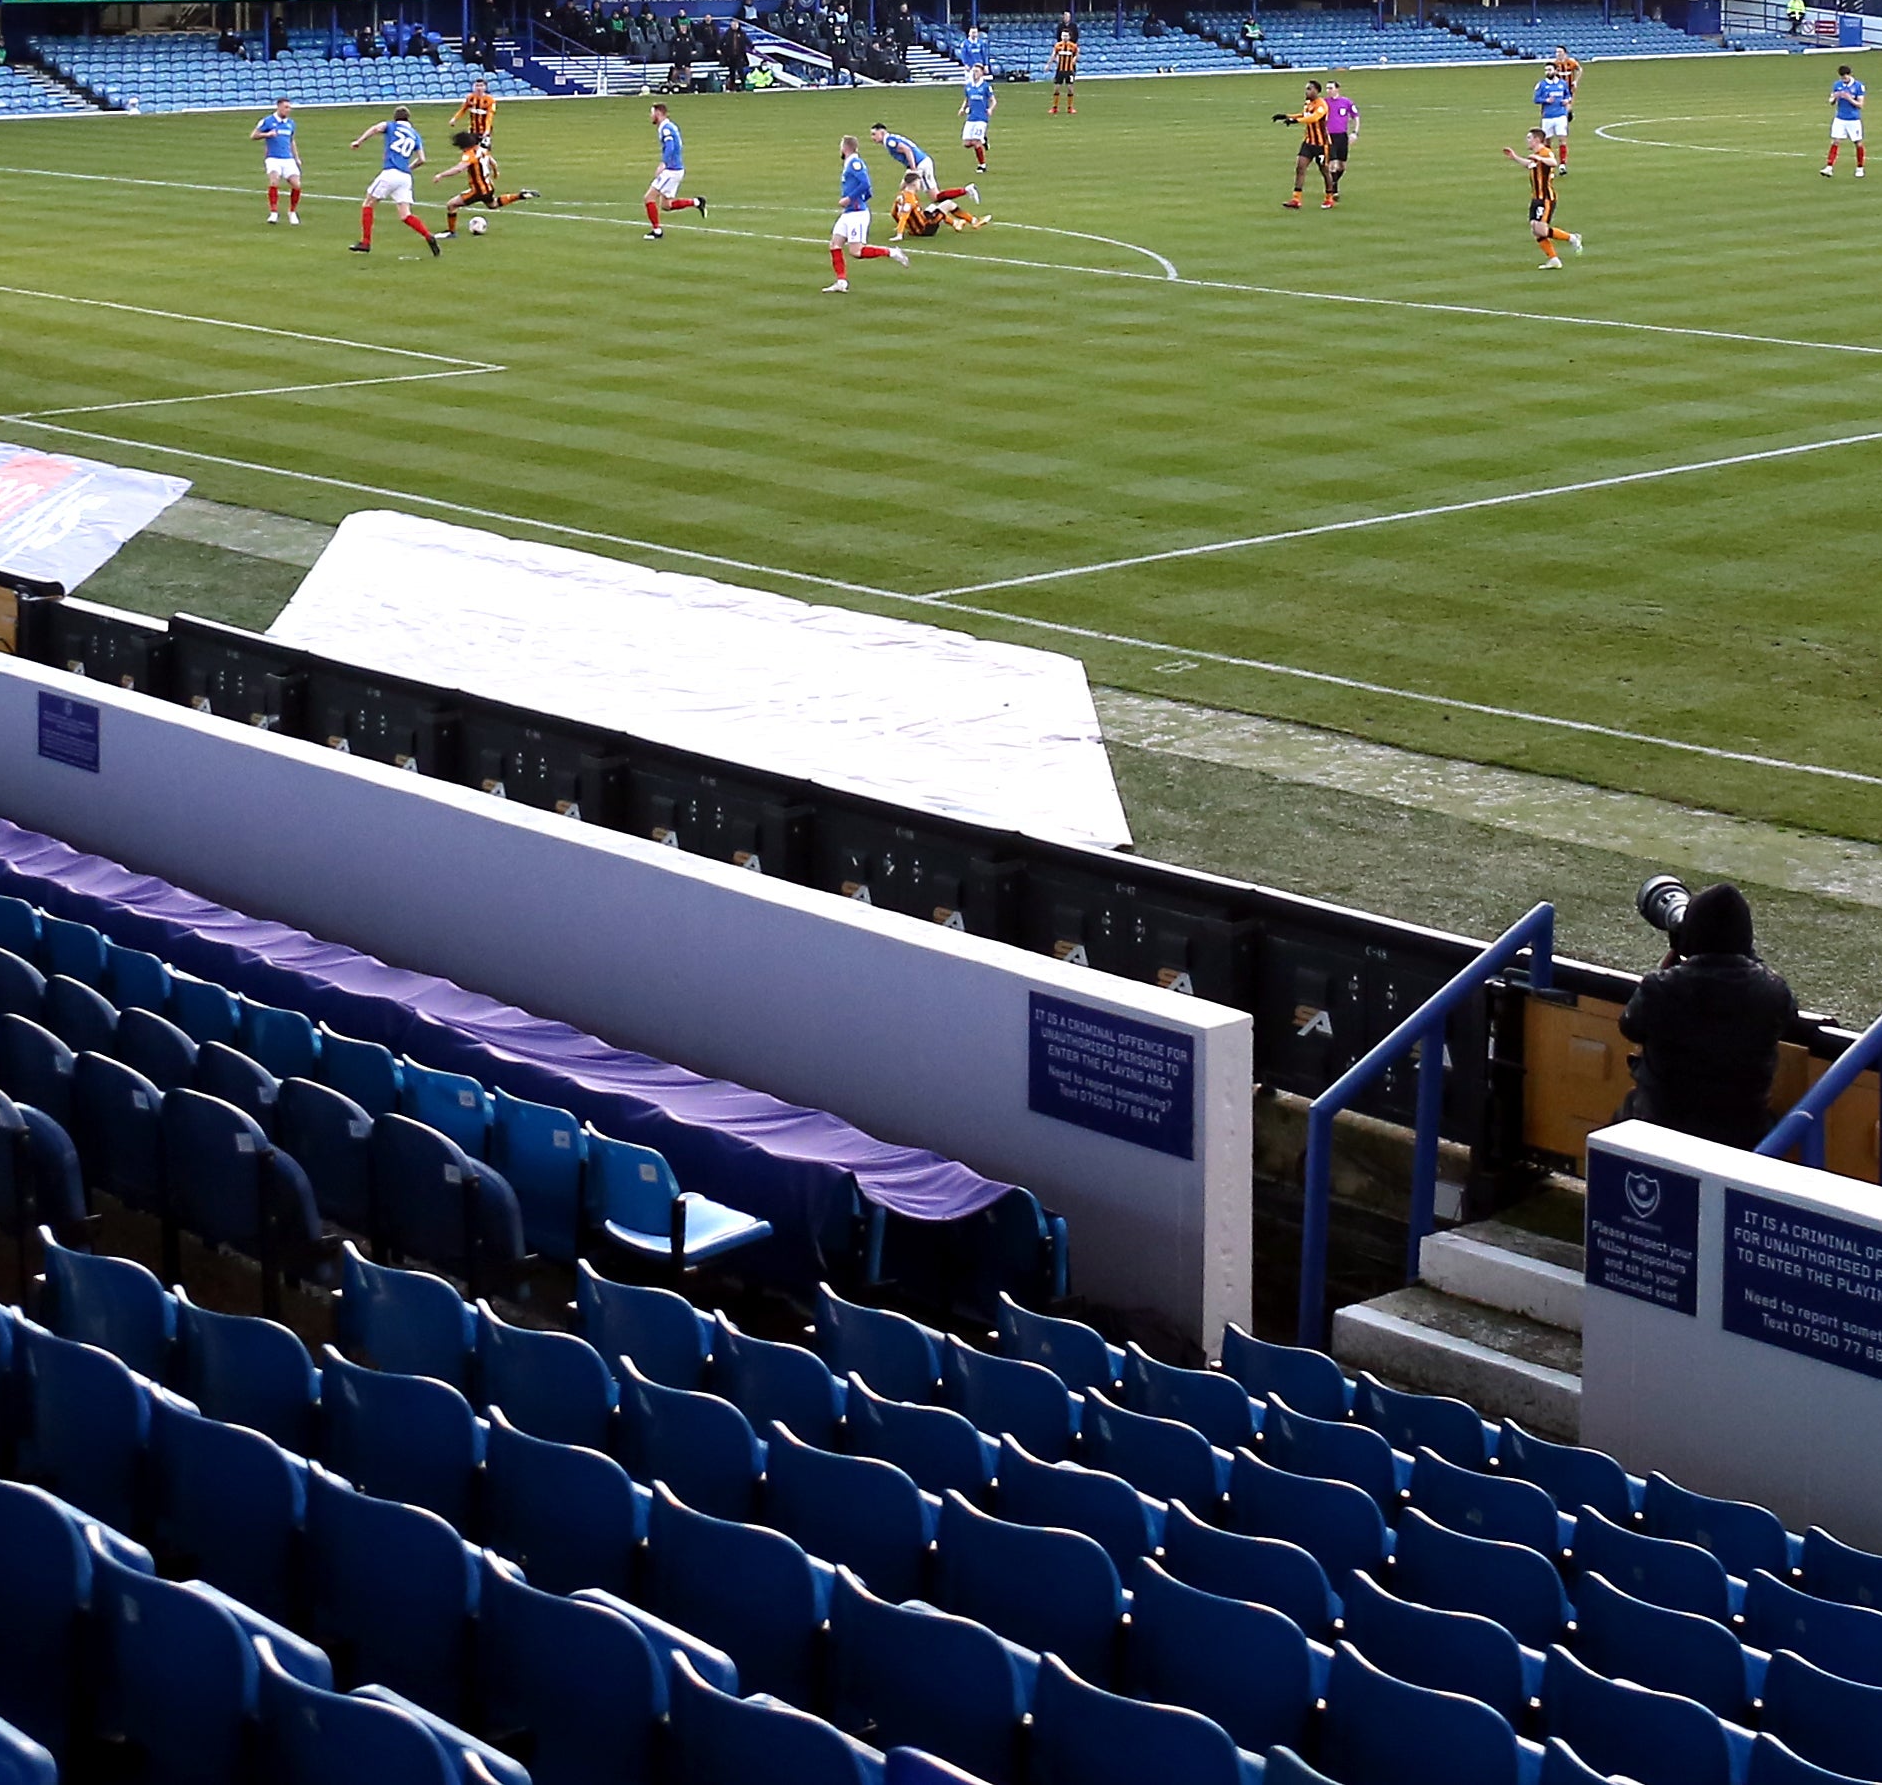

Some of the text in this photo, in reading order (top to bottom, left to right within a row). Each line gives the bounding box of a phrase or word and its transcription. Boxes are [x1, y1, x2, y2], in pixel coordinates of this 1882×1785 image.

[390, 131, 416, 157] 20
[1035, 1009, 1188, 1062] IT IS CRIMINAL OFFENCE FOR
[1041, 1027, 1180, 1077] UNAUTHORISED PERSONS TO
[1048, 1045, 1174, 1091] ENTER THE PLAYING AREA
[1048, 1064, 1071, 1083] Need
[1085, 1075, 1114, 1096] report
[1059, 1082, 1113, 1111] Text 07500
[1592, 1219, 1628, 1242] Please
[1629, 1231, 1669, 1255] respect
[1671, 1244, 1693, 1262] your
[1734, 1227, 1759, 1247] FOR
[1764, 1235, 1871, 1279] UNAUTHORISED
[1744, 1210, 1759, 1225] IT
[1762, 1215, 1777, 1231] IS
[1780, 1219, 1789, 1234] A
[1792, 1223, 1861, 1258] CRIMINAL
[1597, 1238, 1687, 1276] fellow supporters
[1604, 1257, 1679, 1289] and sit in your
[1737, 1246, 1753, 1264] TO
[1757, 1252, 1802, 1280] ENTER
[1807, 1267, 1833, 1288] THE
[1605, 1272, 1678, 1304] allocated seat
[1744, 1288, 1778, 1310] Need
[1781, 1298, 1794, 1316] to
[1798, 1306, 1838, 1334] report
[1762, 1312, 1789, 1334] Text
[1793, 1324, 1839, 1350] 07500
[1843, 1337, 1861, 1354] 77
